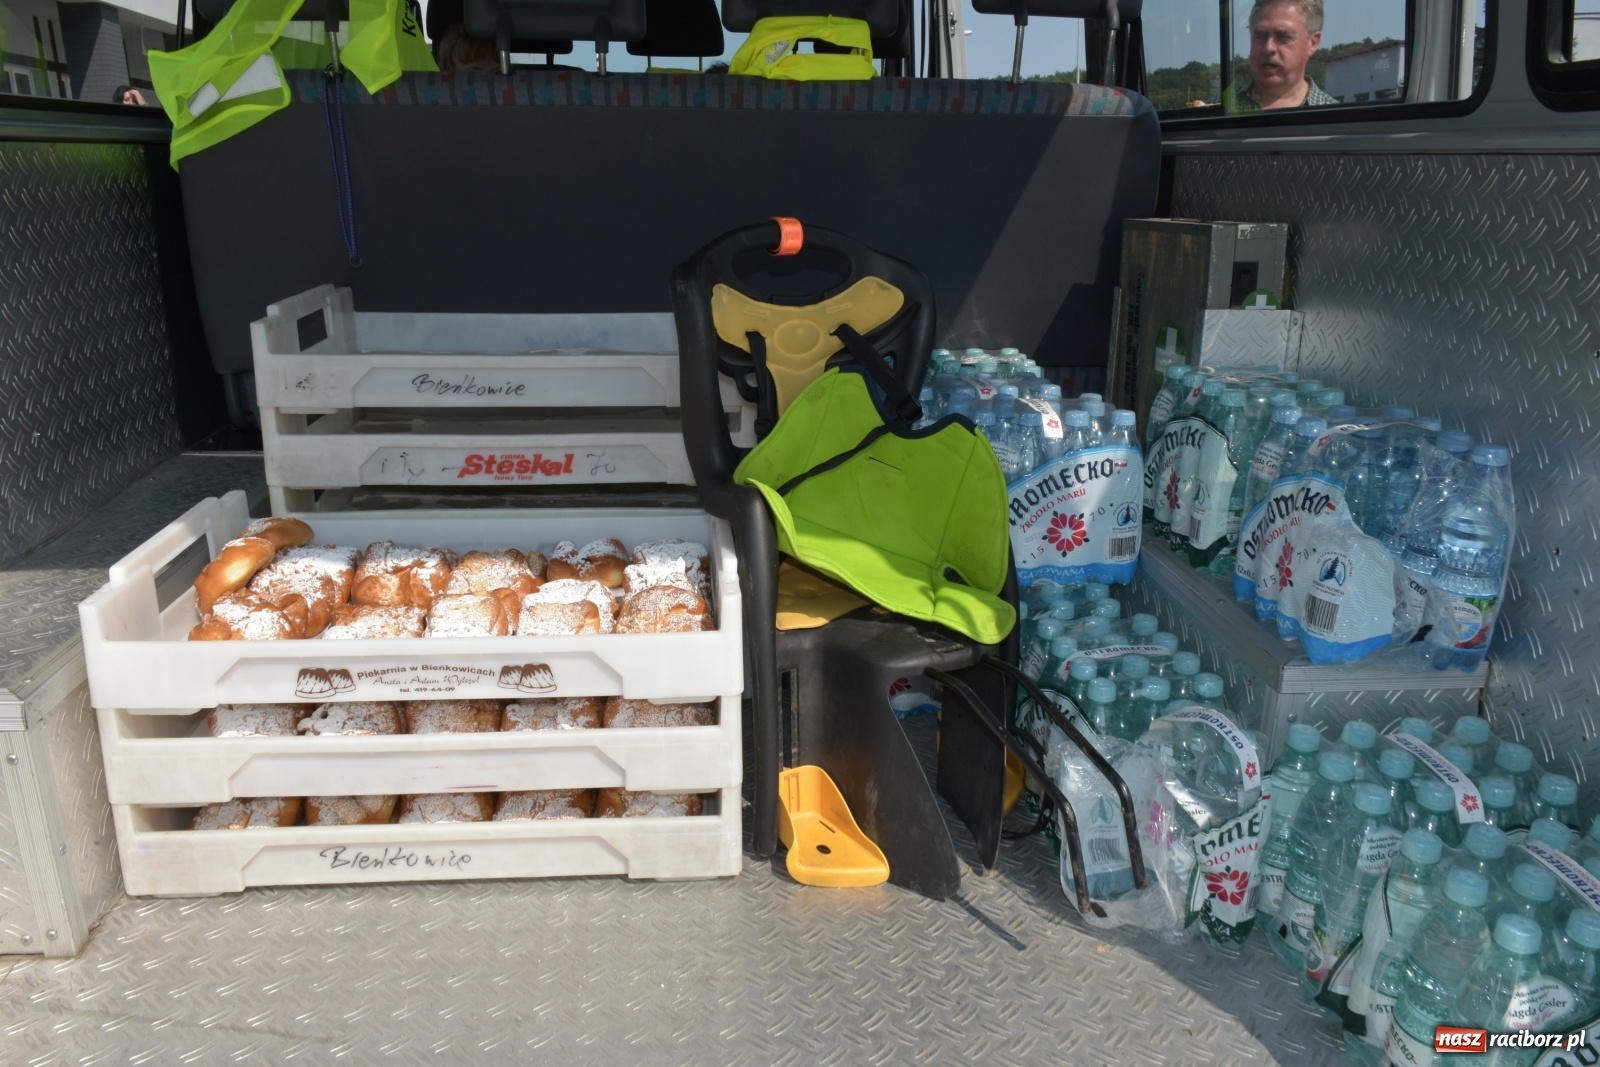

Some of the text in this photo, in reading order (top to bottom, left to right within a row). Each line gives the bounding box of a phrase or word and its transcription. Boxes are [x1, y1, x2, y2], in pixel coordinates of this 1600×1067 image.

[1056, 488, 1086, 504] MARII
[357, 666, 406, 680] Piekarnia
[421, 664, 495, 677] Bieńkowicach
